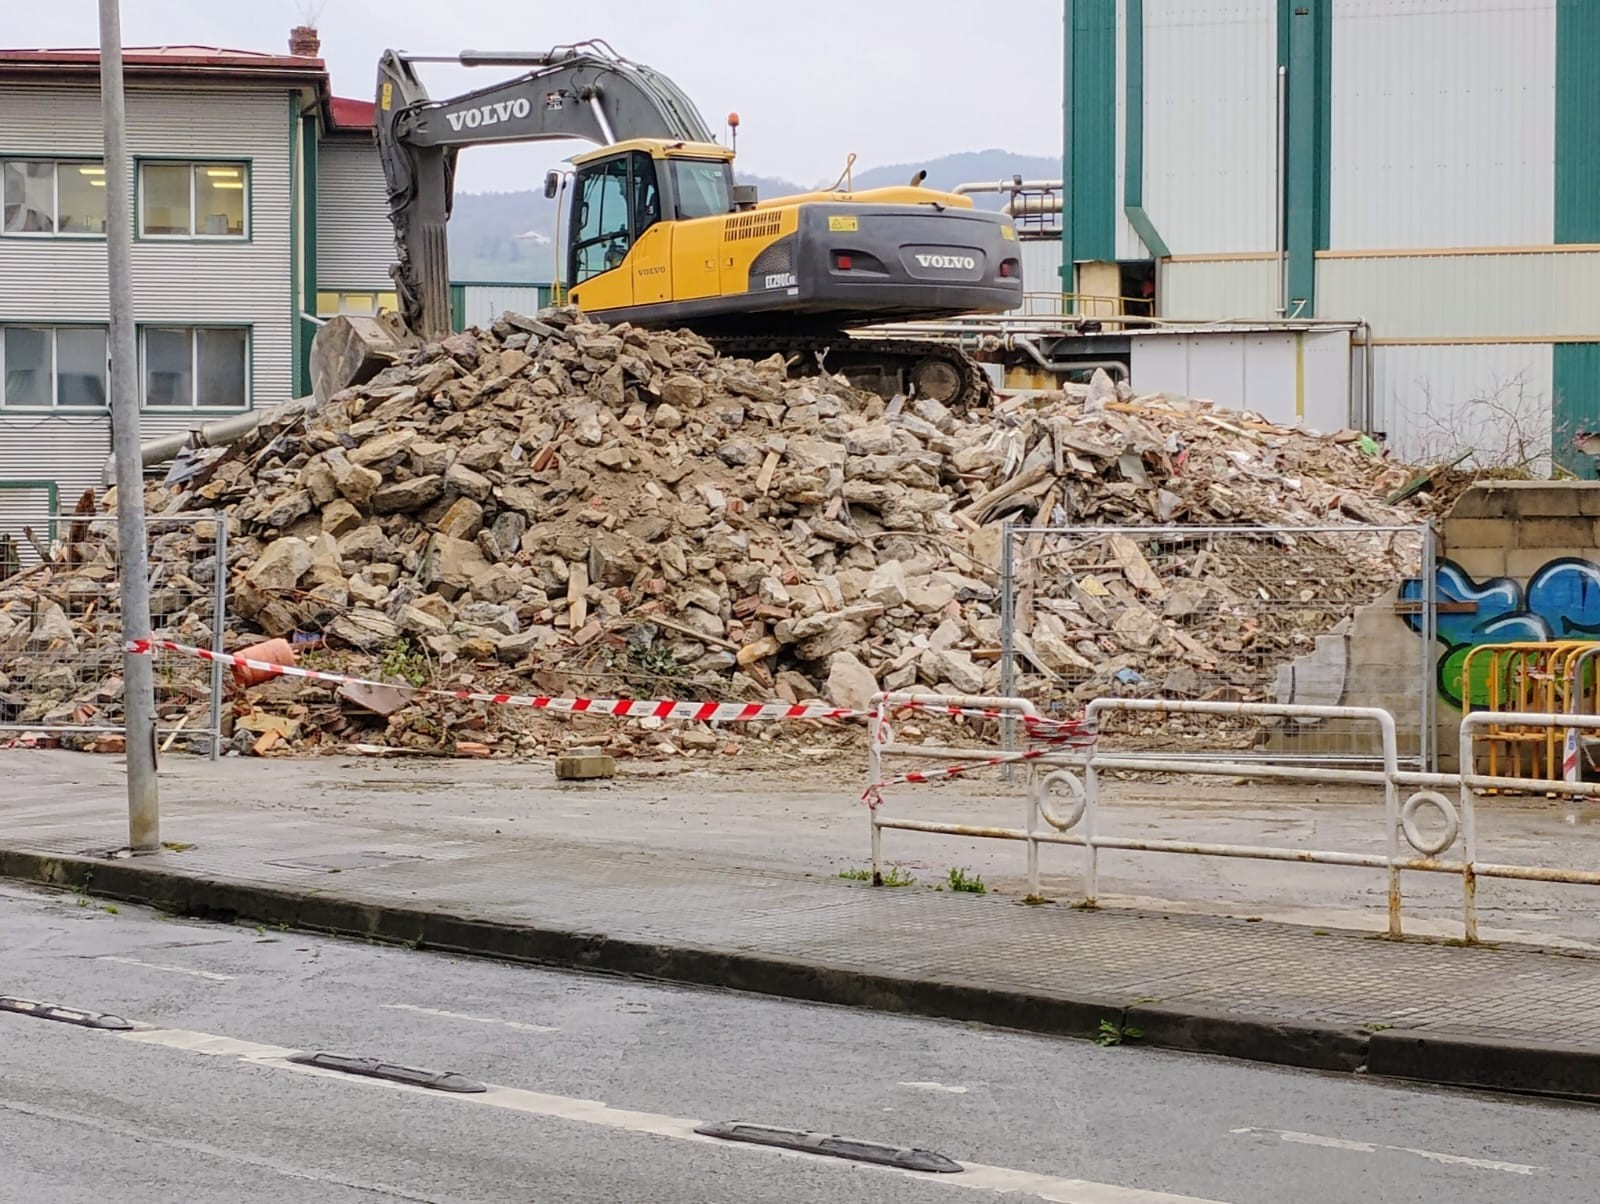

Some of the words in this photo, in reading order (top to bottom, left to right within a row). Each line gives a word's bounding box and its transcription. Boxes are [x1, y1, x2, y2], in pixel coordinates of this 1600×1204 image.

[446, 98, 530, 132] VOLVO
[915, 254, 975, 270] VOLVO
[637, 266, 666, 276] VOLVO
